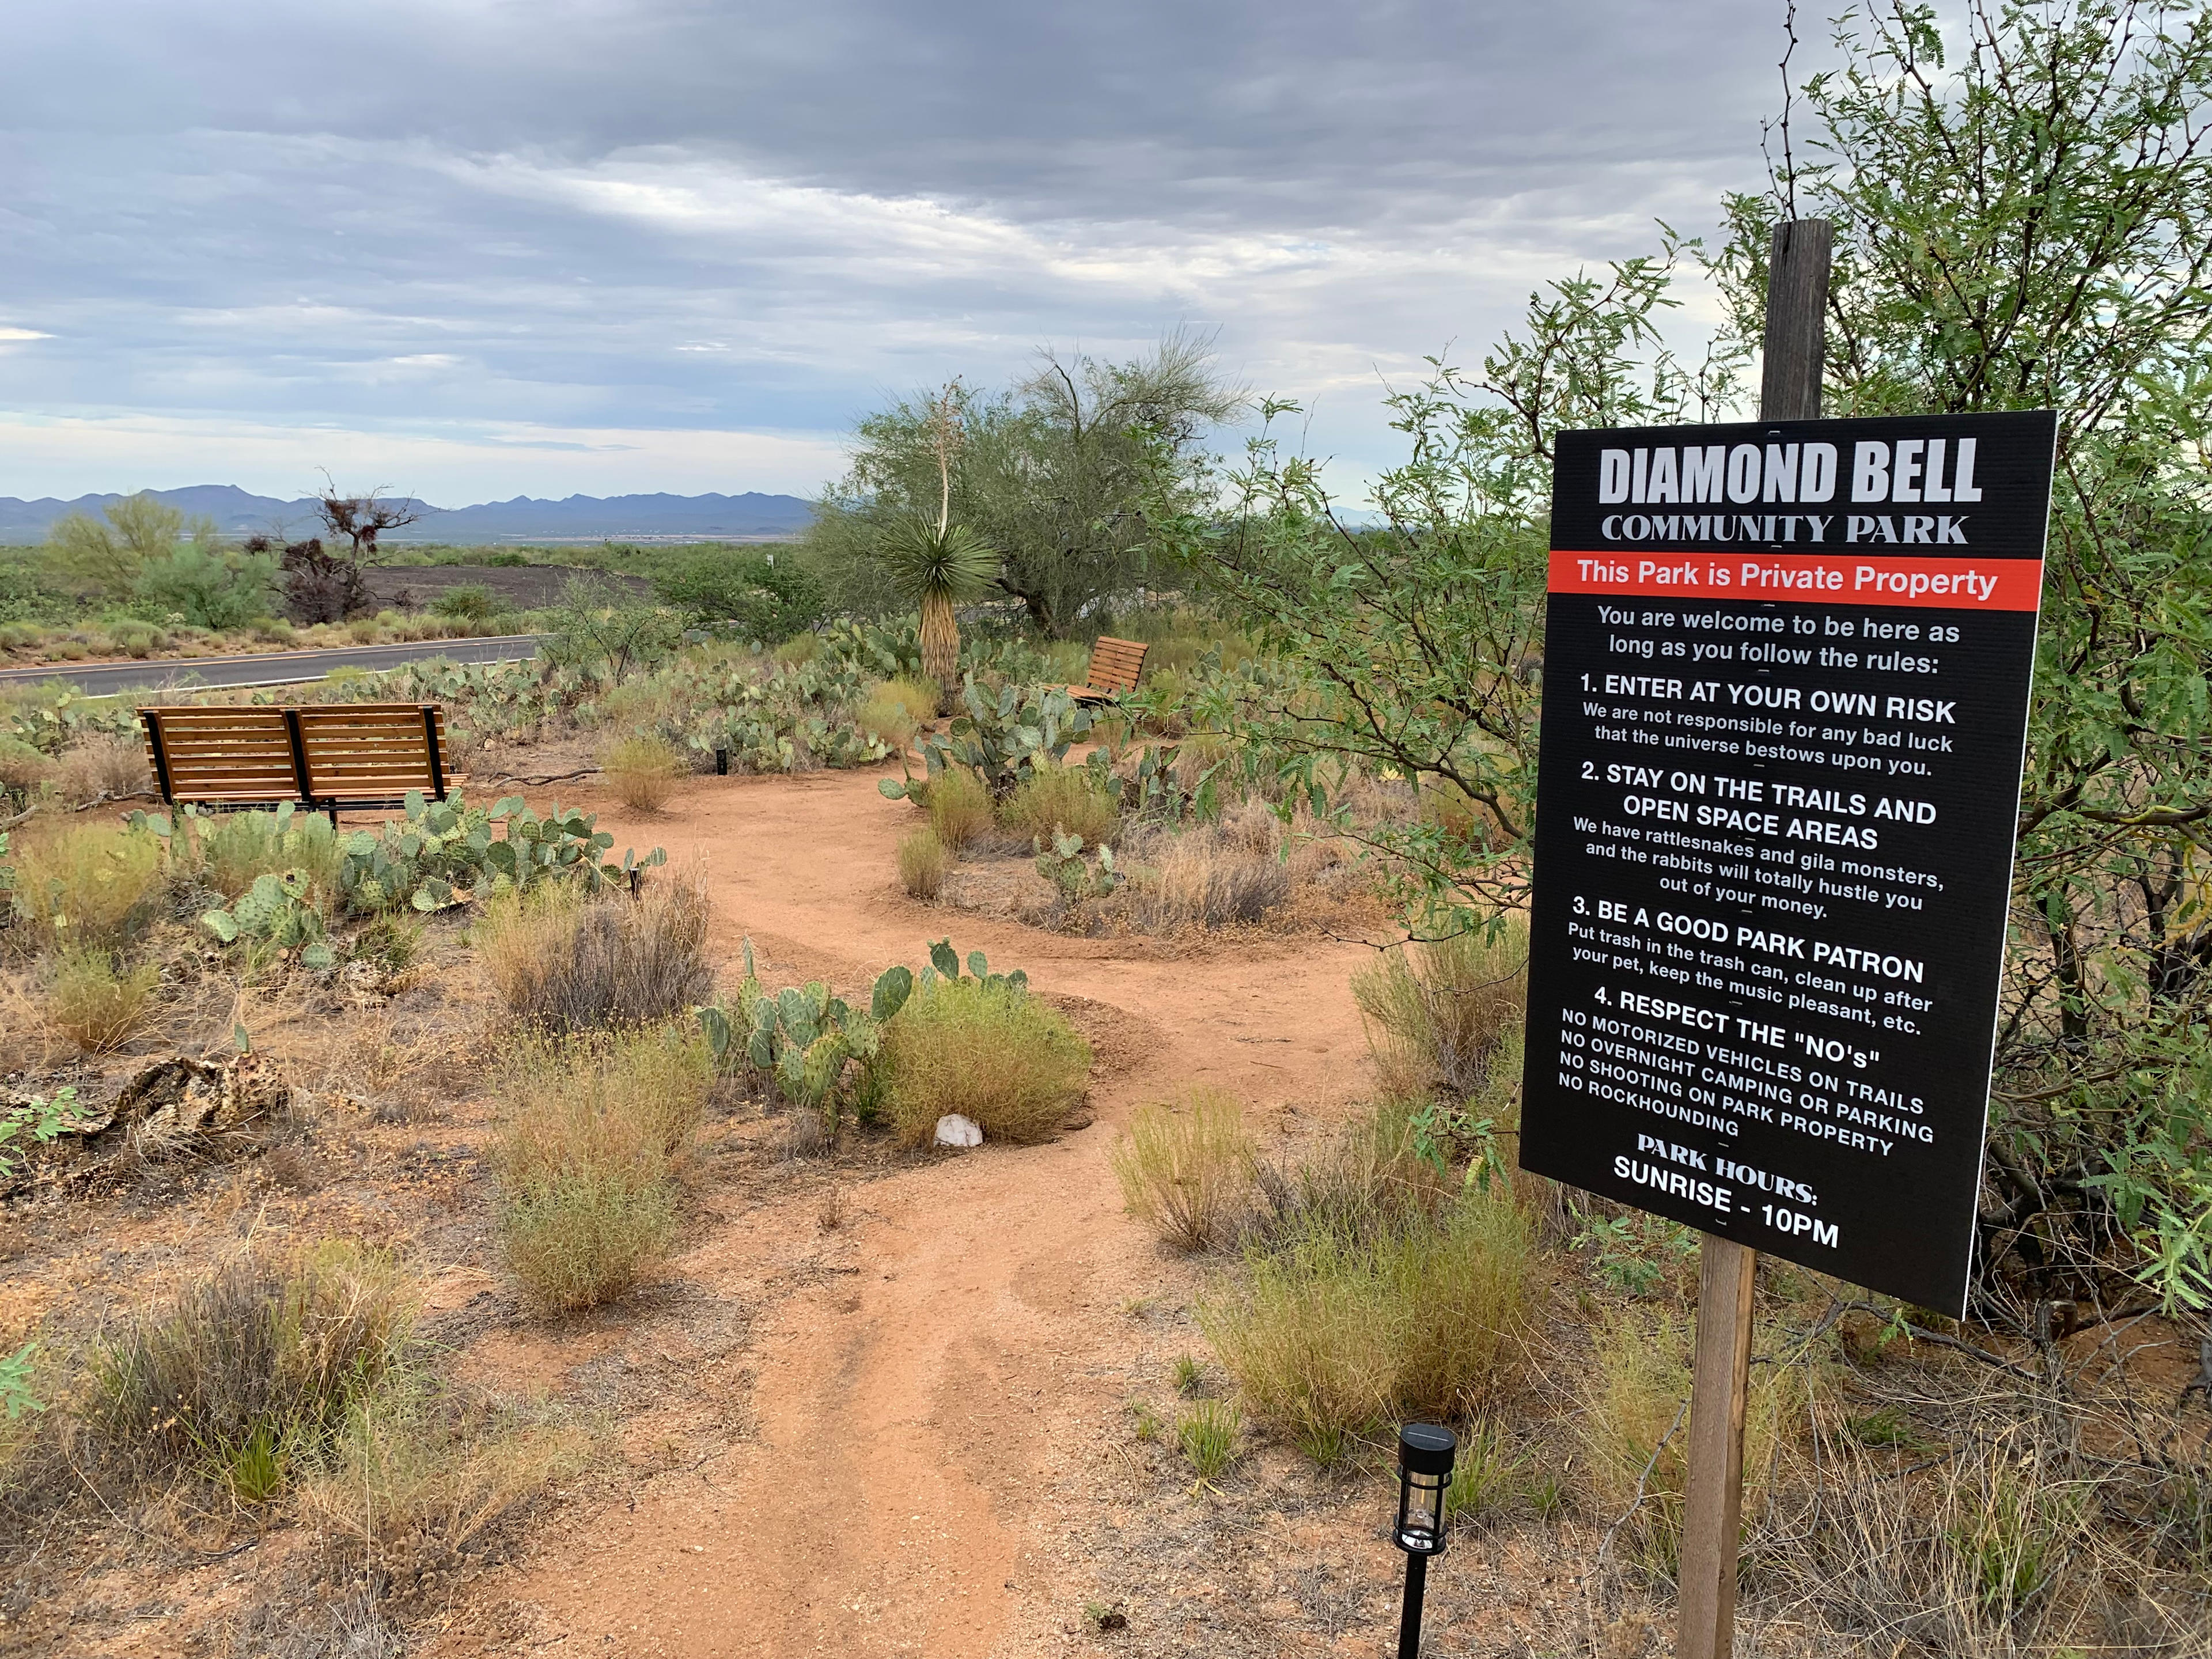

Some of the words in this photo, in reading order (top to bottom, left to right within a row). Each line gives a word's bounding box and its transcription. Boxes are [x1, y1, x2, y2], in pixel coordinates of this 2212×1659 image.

[1599, 442, 1838, 504] DIAMOND
[1851, 438, 1982, 502] BELL
[1601, 514, 1834, 542] COMMUNITY
[1845, 516, 1969, 544] PARK
[1577, 559, 1629, 583] This
[1638, 560, 1699, 585] Park
[1708, 562, 1730, 586] is
[1741, 563, 1844, 590] Private
[1854, 566, 1998, 601] Property
[1597, 605, 1635, 625] You
[1641, 612, 1675, 627] are
[1682, 611, 1785, 632] welcome
[1792, 615, 1816, 634] to
[1824, 616, 1854, 637] be
[1863, 618, 1920, 641] here
[1929, 626, 1960, 642] as
[1609, 634, 1654, 658] long
[1661, 641, 1685, 657] as
[1692, 643, 1733, 661] you
[1740, 642, 1812, 665] follow
[1819, 647, 1858, 668] the
[1866, 651, 1938, 674] rules:
[1581, 673, 1597, 692] 1.
[1605, 674, 1683, 699] ENTER
[1689, 681, 1721, 702] AT
[1727, 683, 1801, 710] YOUR
[1810, 690, 1877, 717] OWN
[1886, 696, 1957, 724] RISK
[1583, 702, 1607, 718] We
[1612, 708, 1638, 721] are
[1643, 710, 1672, 724] not
[1677, 714, 1783, 735] responsible
[1789, 721, 1817, 738] for
[1821, 728, 1857, 746] any
[1863, 728, 1902, 747] bad
[1908, 732, 1953, 752] luck
[1594, 725, 1627, 742] that
[1632, 729, 1659, 745] the
[1665, 734, 1740, 754] universe
[1745, 740, 1825, 764] bestows
[1832, 753, 1881, 770] upon
[1888, 759, 1931, 776] you.
[1581, 761, 1599, 781] 2.
[1607, 764, 1664, 788] STAY
[1671, 771, 1706, 794] ON
[1714, 777, 1763, 802] THE
[1771, 783, 1866, 816] TRAILS
[1873, 797, 1937, 824] AND
[1623, 795, 1689, 823] OPEN
[1696, 805, 1779, 836] SPACE
[1786, 818, 1878, 850] AREAS
[1573, 816, 1597, 833] We
[1602, 820, 1641, 840] have
[1646, 831, 1754, 858] rattlesnakes
[1760, 849, 1794, 865] and
[1801, 853, 1835, 871] gila
[1842, 861, 1944, 892] monsters,
[1586, 843, 1616, 858] and
[1620, 846, 1647, 863] the
[1653, 853, 1713, 874] rabbits
[1718, 863, 1749, 880] will
[1754, 868, 1813, 894] totally
[1819, 878, 1879, 903] hustle
[1885, 893, 1923, 910] you
[1660, 877, 1688, 892] out
[1693, 882, 1711, 896] of
[1715, 887, 1756, 904] your
[1762, 895, 1827, 920] money.
[1568, 922, 1595, 940] Put
[1599, 929, 1641, 950] trash
[1646, 938, 1661, 955] in
[1666, 943, 1694, 961] the
[1699, 949, 1744, 972] trash
[1751, 964, 1789, 984] can,
[1795, 971, 1846, 994] clean
[1853, 984, 1877, 1003] up
[1884, 991, 1933, 1012] after
[1573, 896, 1590, 916] 3.
[1598, 900, 1627, 923] BE
[1633, 907, 1650, 928] A
[1657, 911, 1729, 942] GOOD
[1737, 926, 1805, 959] PARK
[1813, 941, 1924, 983] PATRON
[1573, 947, 1608, 964] your
[1613, 956, 1643, 975] pet,
[1649, 960, 1690, 984] keep
[1695, 971, 1724, 990] the
[1729, 981, 1783, 1003] music
[1789, 993, 1876, 1028] pleasant,
[1883, 1016, 1921, 1035] etc.
[1594, 986, 1612, 1006] 4.
[1620, 990, 1730, 1033] RESPECT
[1736, 1018, 1786, 1048] THE
[1795, 1032, 1880, 1069] "NO's"
[1561, 1029, 1585, 1048] NO
[1591, 1038, 1696, 1077] OVERNIGHT
[1702, 1067, 1792, 1104] CAMPING
[1800, 1093, 1828, 1115] OR
[1836, 1103, 1933, 1143] PARKING
[1562, 1008, 1586, 1026] NO
[1592, 1016, 1700, 1055] MOTORIZED
[1706, 1044, 1802, 1082] VEHICLES
[1809, 1071, 1839, 1092] ON
[1846, 1080, 1923, 1115] TRAILS
[1559, 1072, 1583, 1090] NO
[1589, 1080, 1738, 1137] ROCKHOUNDING
[1560, 1051, 1584, 1069] NO
[1589, 1059, 1682, 1097] SHOOTING
[1688, 1087, 1715, 1107] ON
[1722, 1095, 1774, 1123] PARK
[1781, 1112, 1894, 1156] PROPERTY
[1613, 1156, 1732, 1213] SUNRISE
[1762, 1204, 1839, 1248] 10PM
[1638, 1133, 1707, 1171] PARK
[1715, 1157, 1817, 1206] HOURS:
